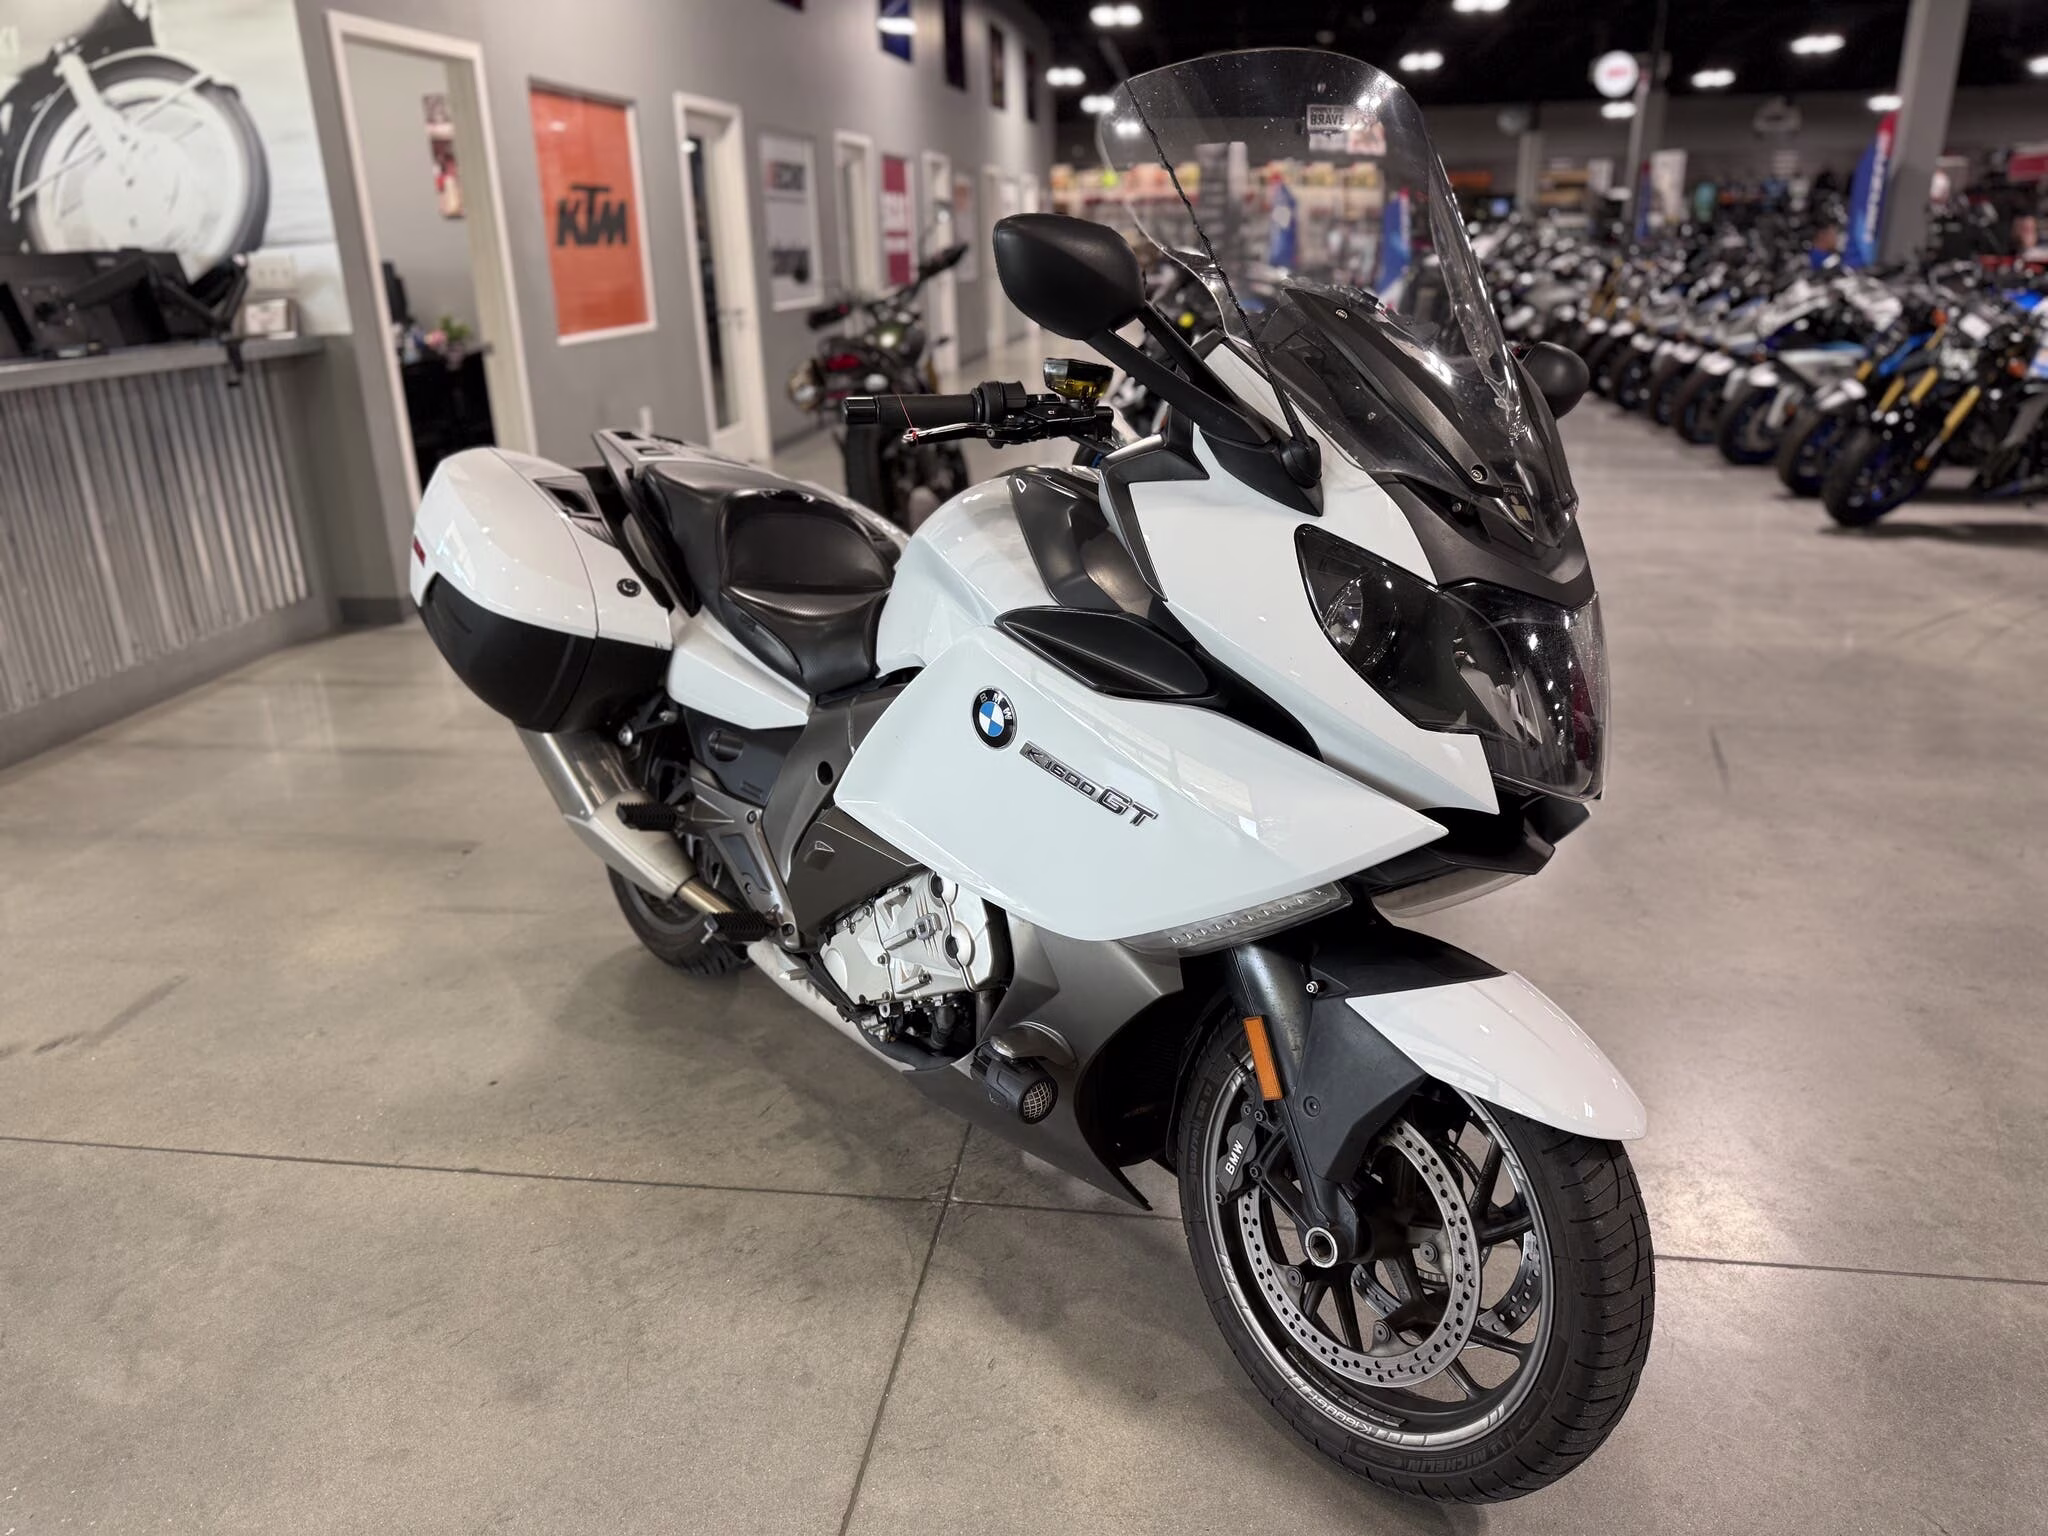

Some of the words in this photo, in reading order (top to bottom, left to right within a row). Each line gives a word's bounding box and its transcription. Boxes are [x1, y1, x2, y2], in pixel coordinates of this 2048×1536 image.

[556, 184, 628, 247] KTM
[980, 692, 1013, 721] BMW
[1225, 1139, 1244, 1176] BMW
[1407, 1447, 1487, 1473] MICHELIN
